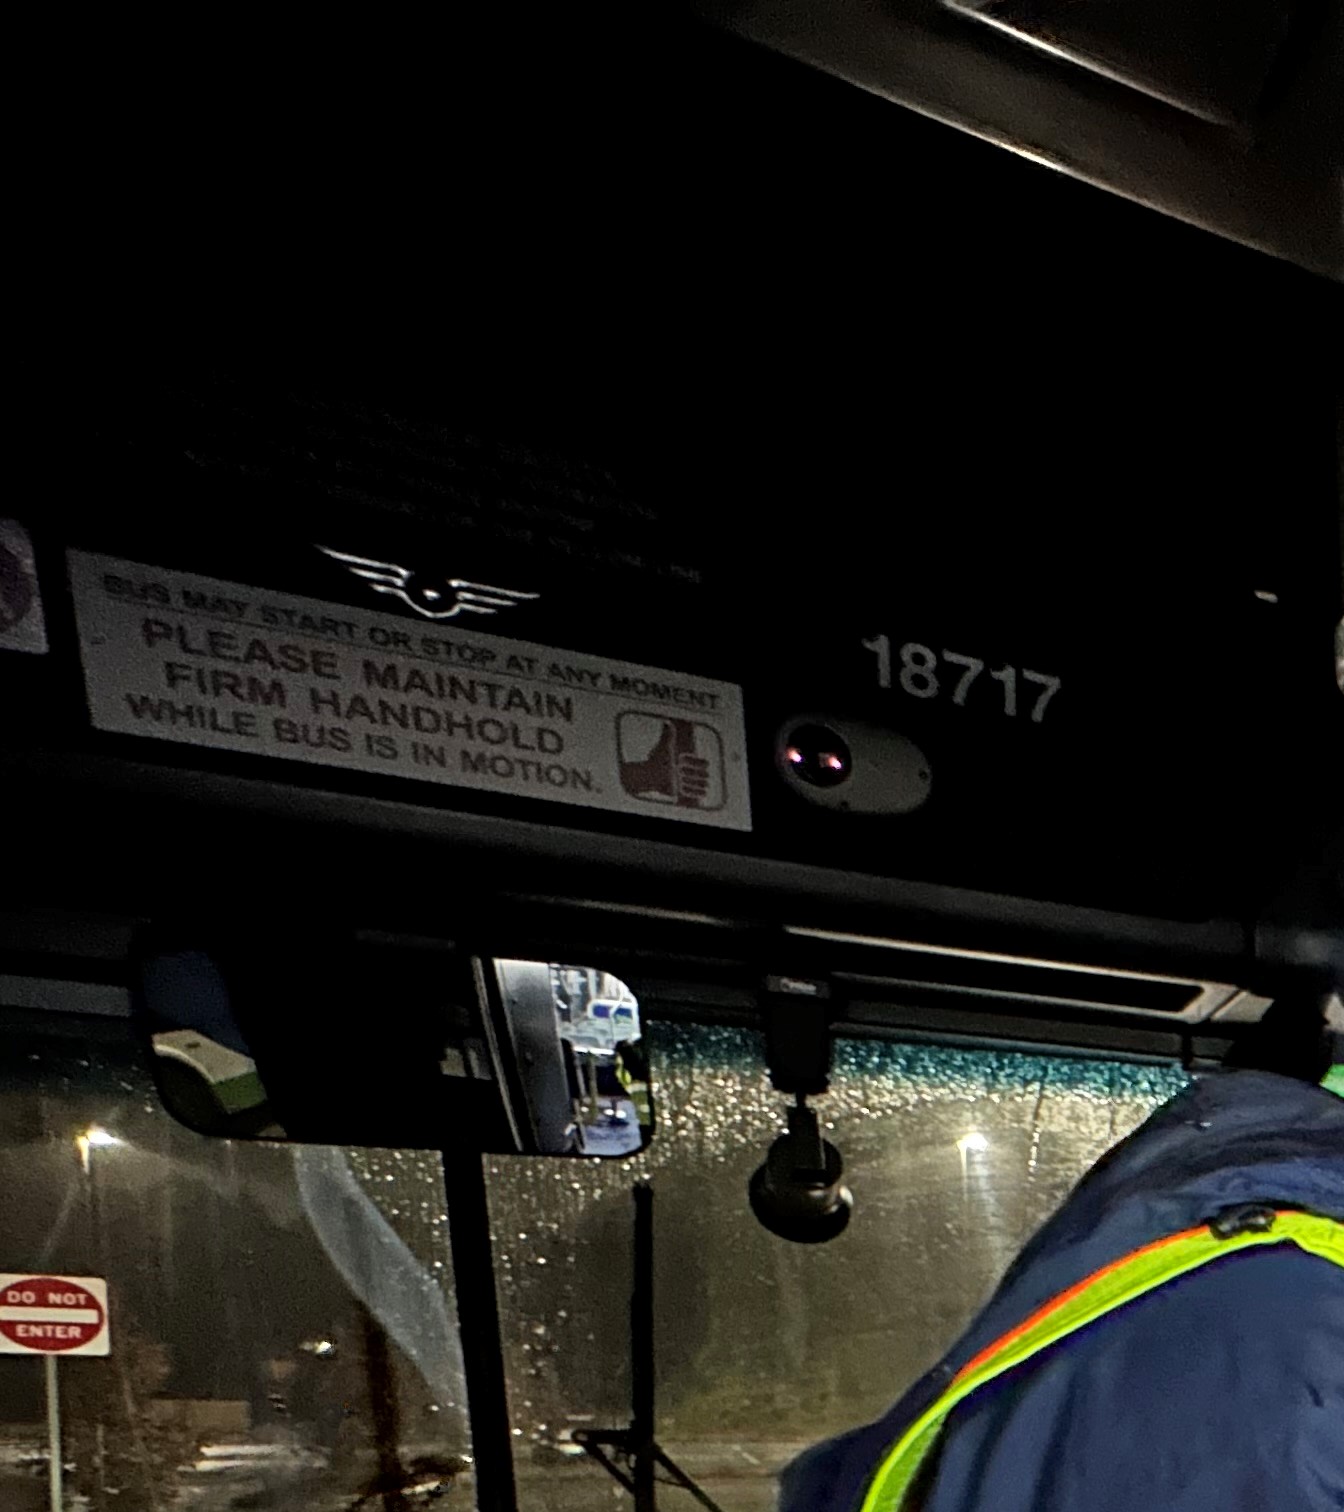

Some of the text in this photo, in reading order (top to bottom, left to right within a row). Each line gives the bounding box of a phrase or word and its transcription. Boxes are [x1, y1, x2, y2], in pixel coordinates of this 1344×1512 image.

[103, 574, 721, 710] BUS MAY START OR STOP AT ANY MOMENT
[141, 616, 574, 723] PLEASE MAINTAIN
[861, 634, 1063, 723] 18717
[124, 692, 604, 794] WHILE BUS IS IN MOTION.
[163, 660, 565, 755] FIRM HANDHOLD
[6, 1290, 88, 1305] DO NOT
[16, 1324, 82, 1338] ENTER
